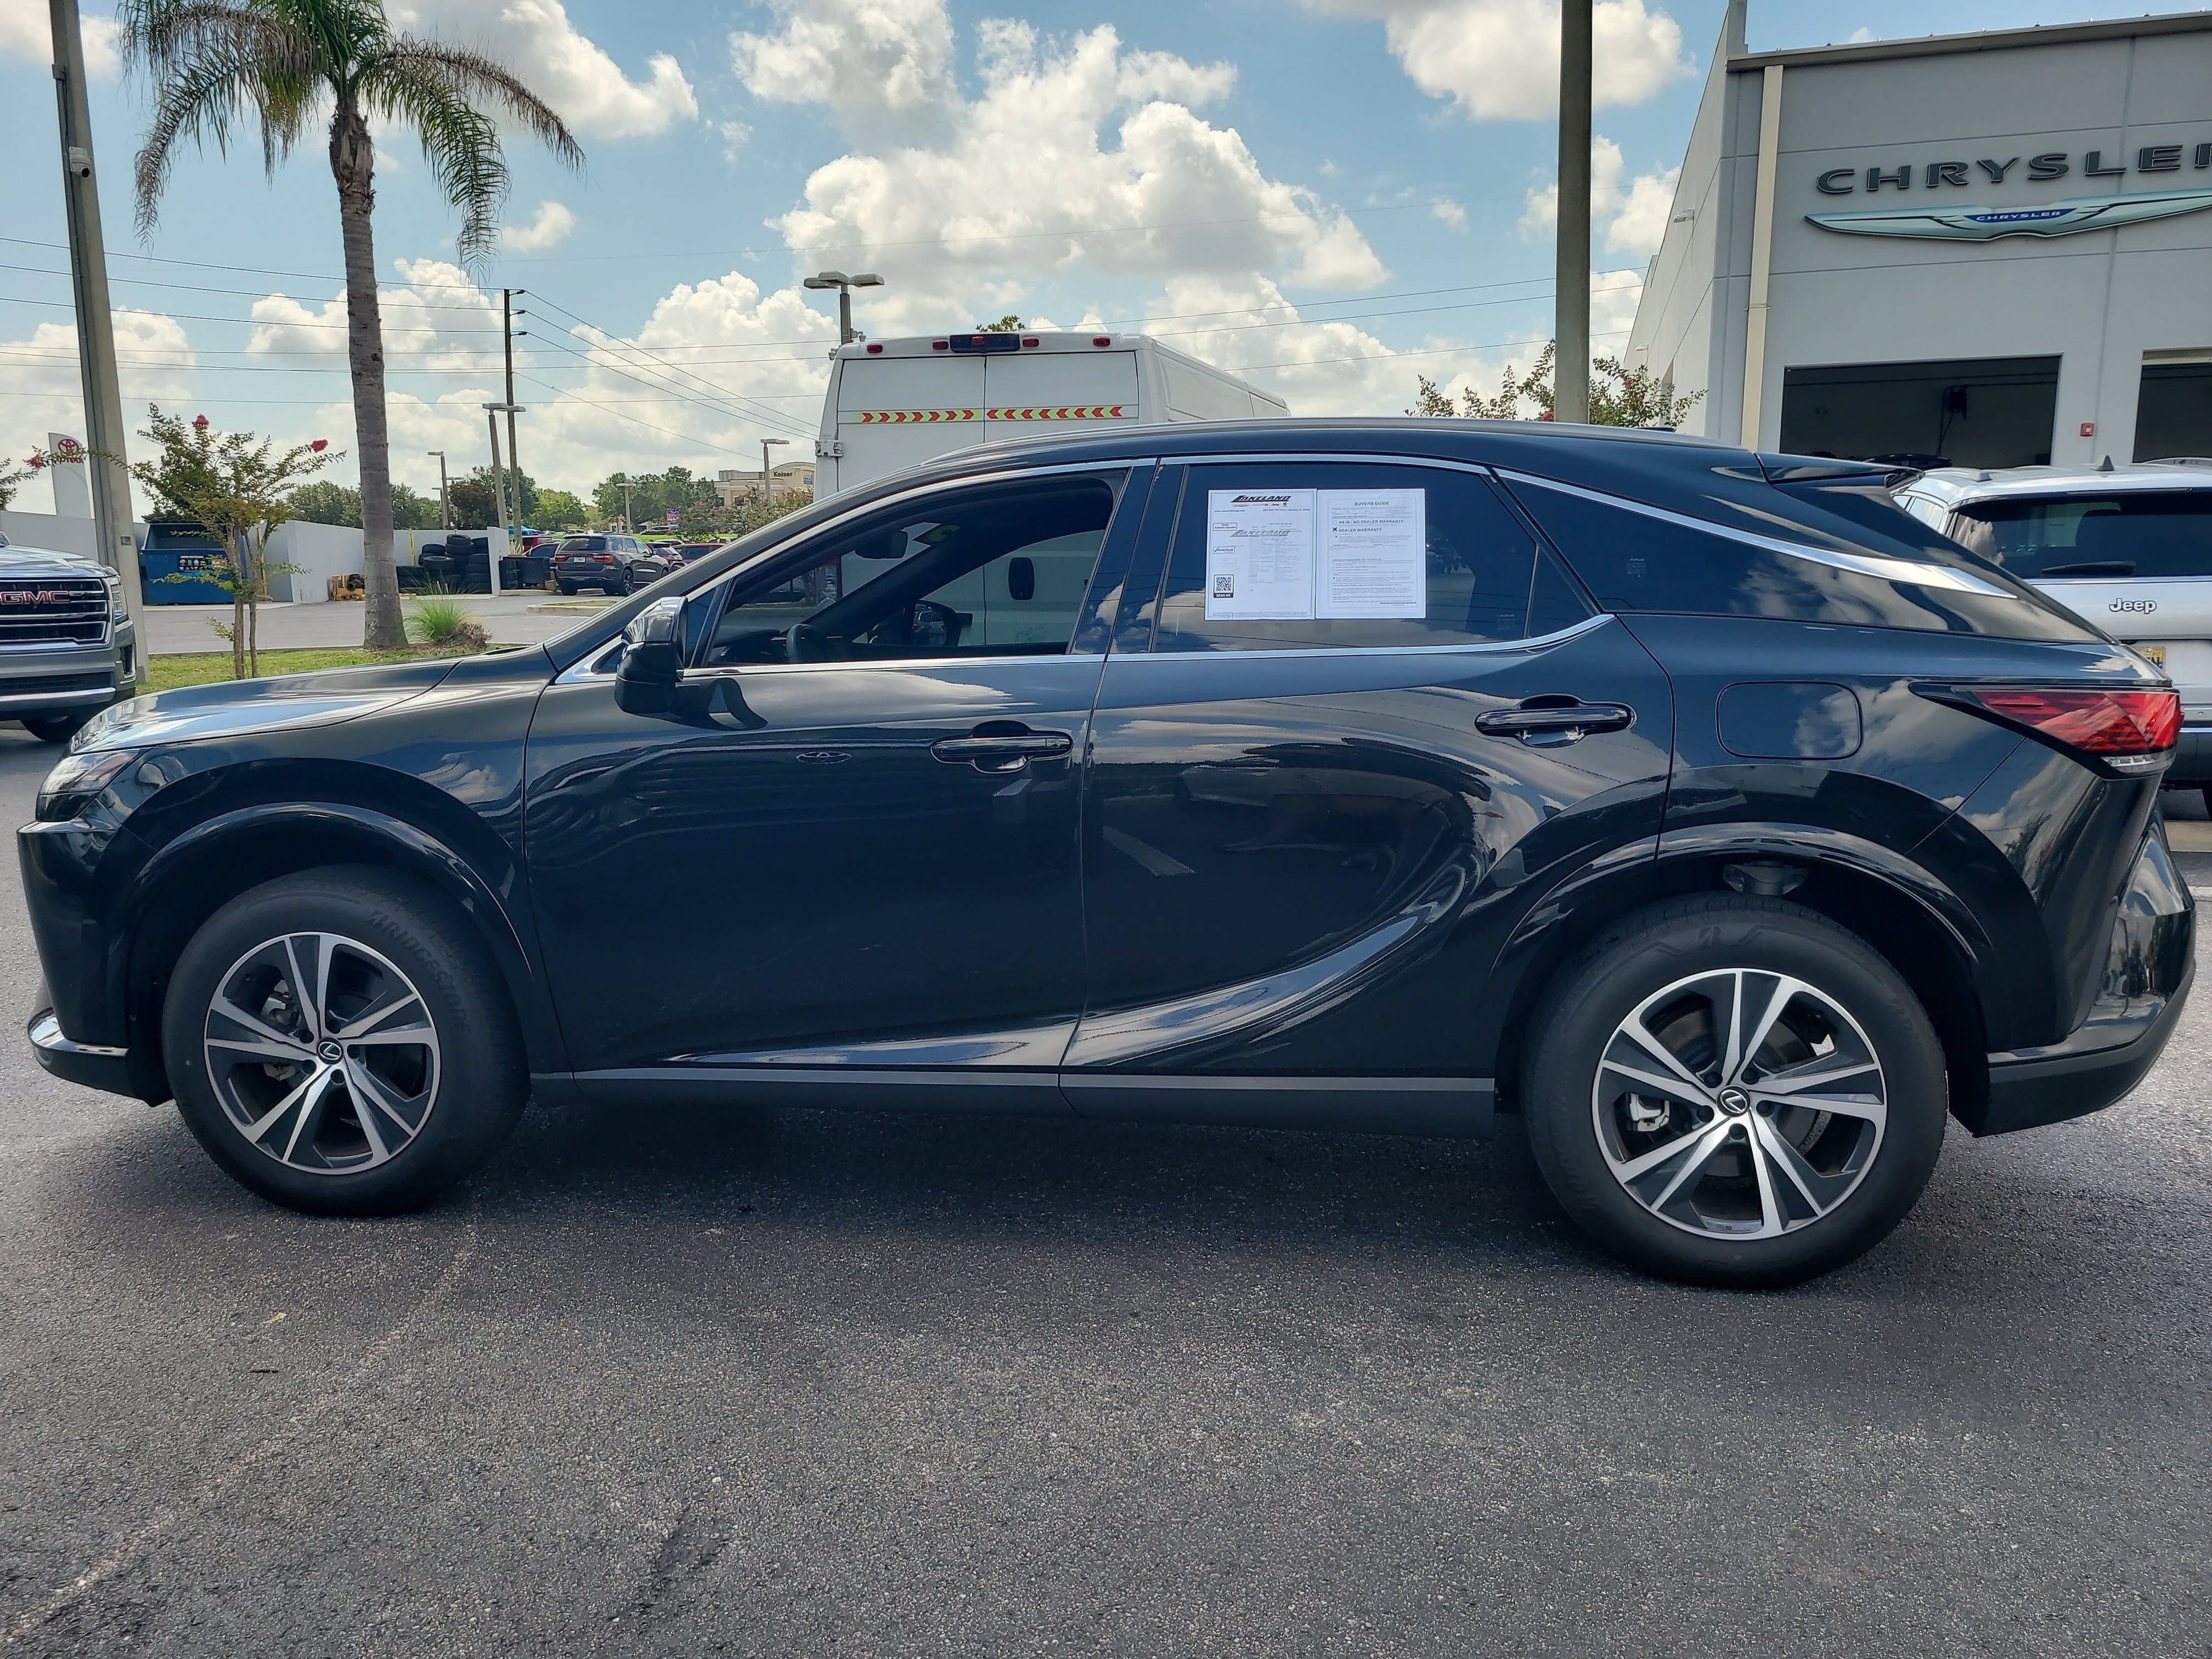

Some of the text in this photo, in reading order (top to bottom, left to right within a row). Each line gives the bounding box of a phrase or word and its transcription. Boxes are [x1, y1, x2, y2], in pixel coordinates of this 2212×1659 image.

[1976, 211, 2062, 221] CHRYSLER
[0, 591, 70, 604] GMC
[2109, 598, 2157, 614] Jeep
